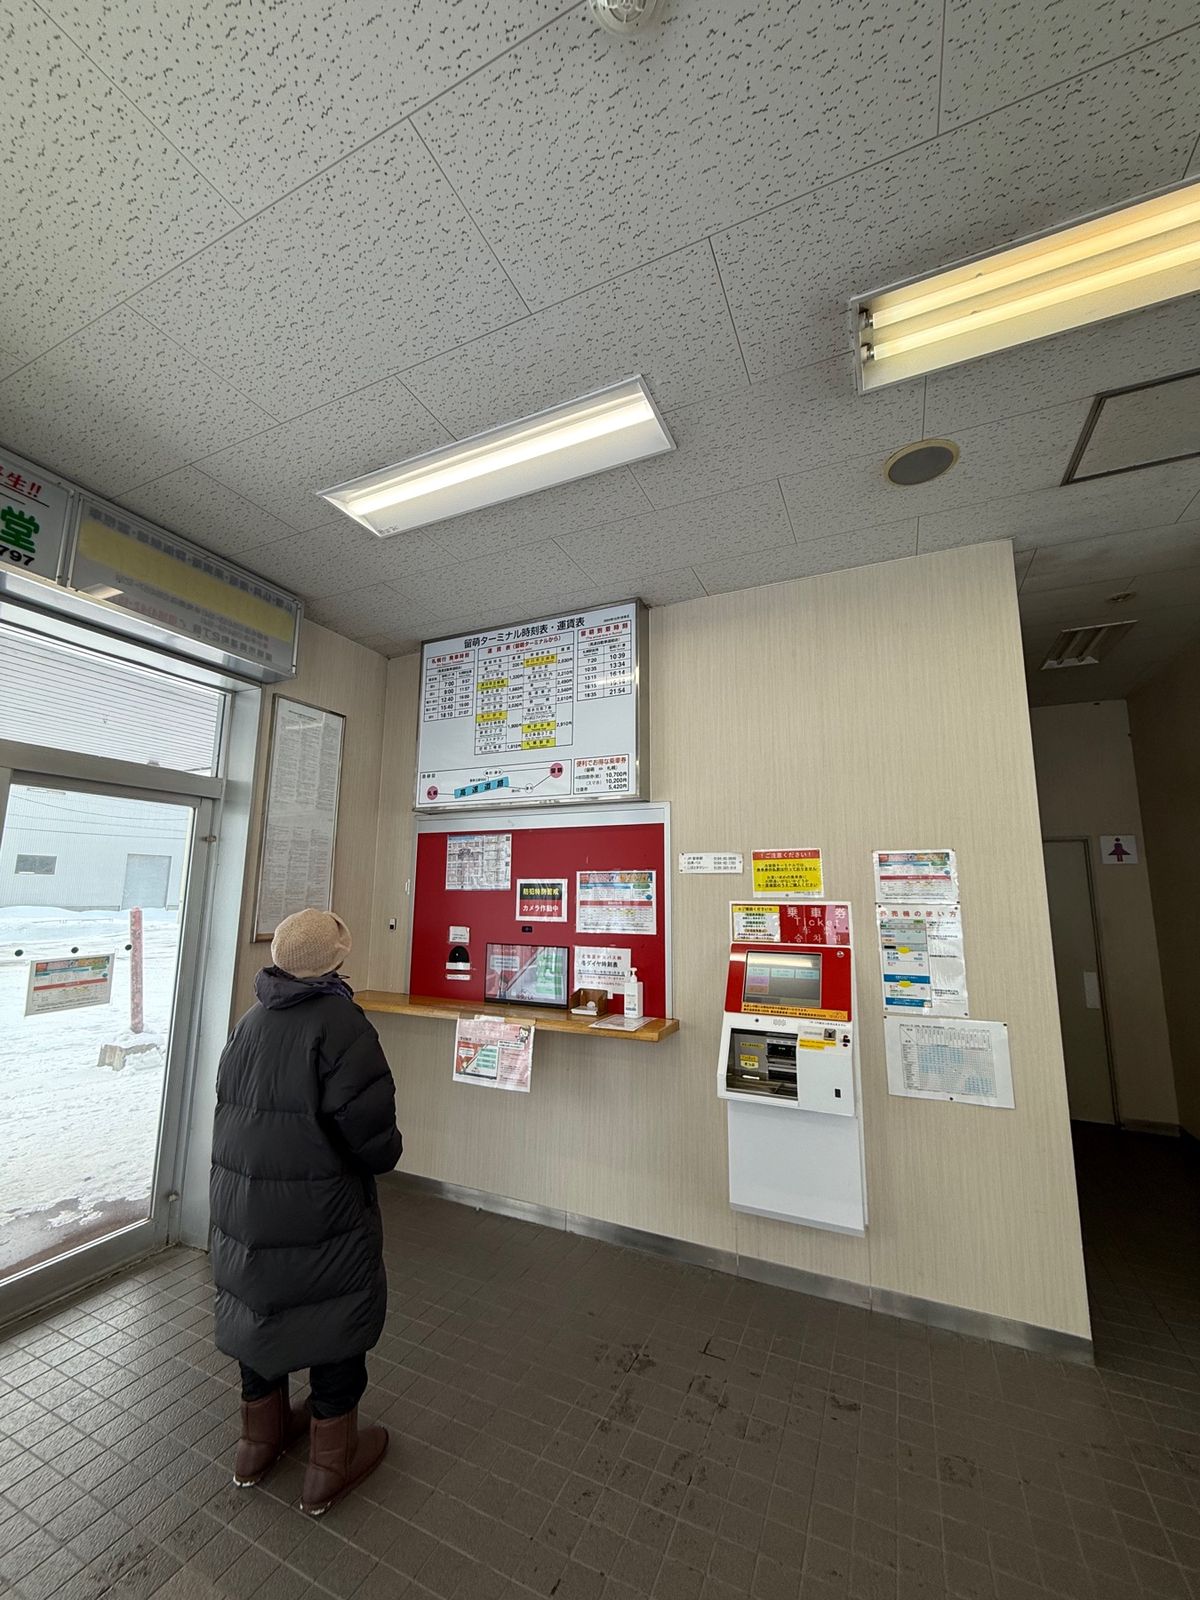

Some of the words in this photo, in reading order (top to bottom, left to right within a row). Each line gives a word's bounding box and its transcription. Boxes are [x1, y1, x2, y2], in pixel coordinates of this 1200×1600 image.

[464, 616, 585, 649] 留萌ターミナル時刻表・運賃表
[522, 904, 559, 912] カメラ作動中
